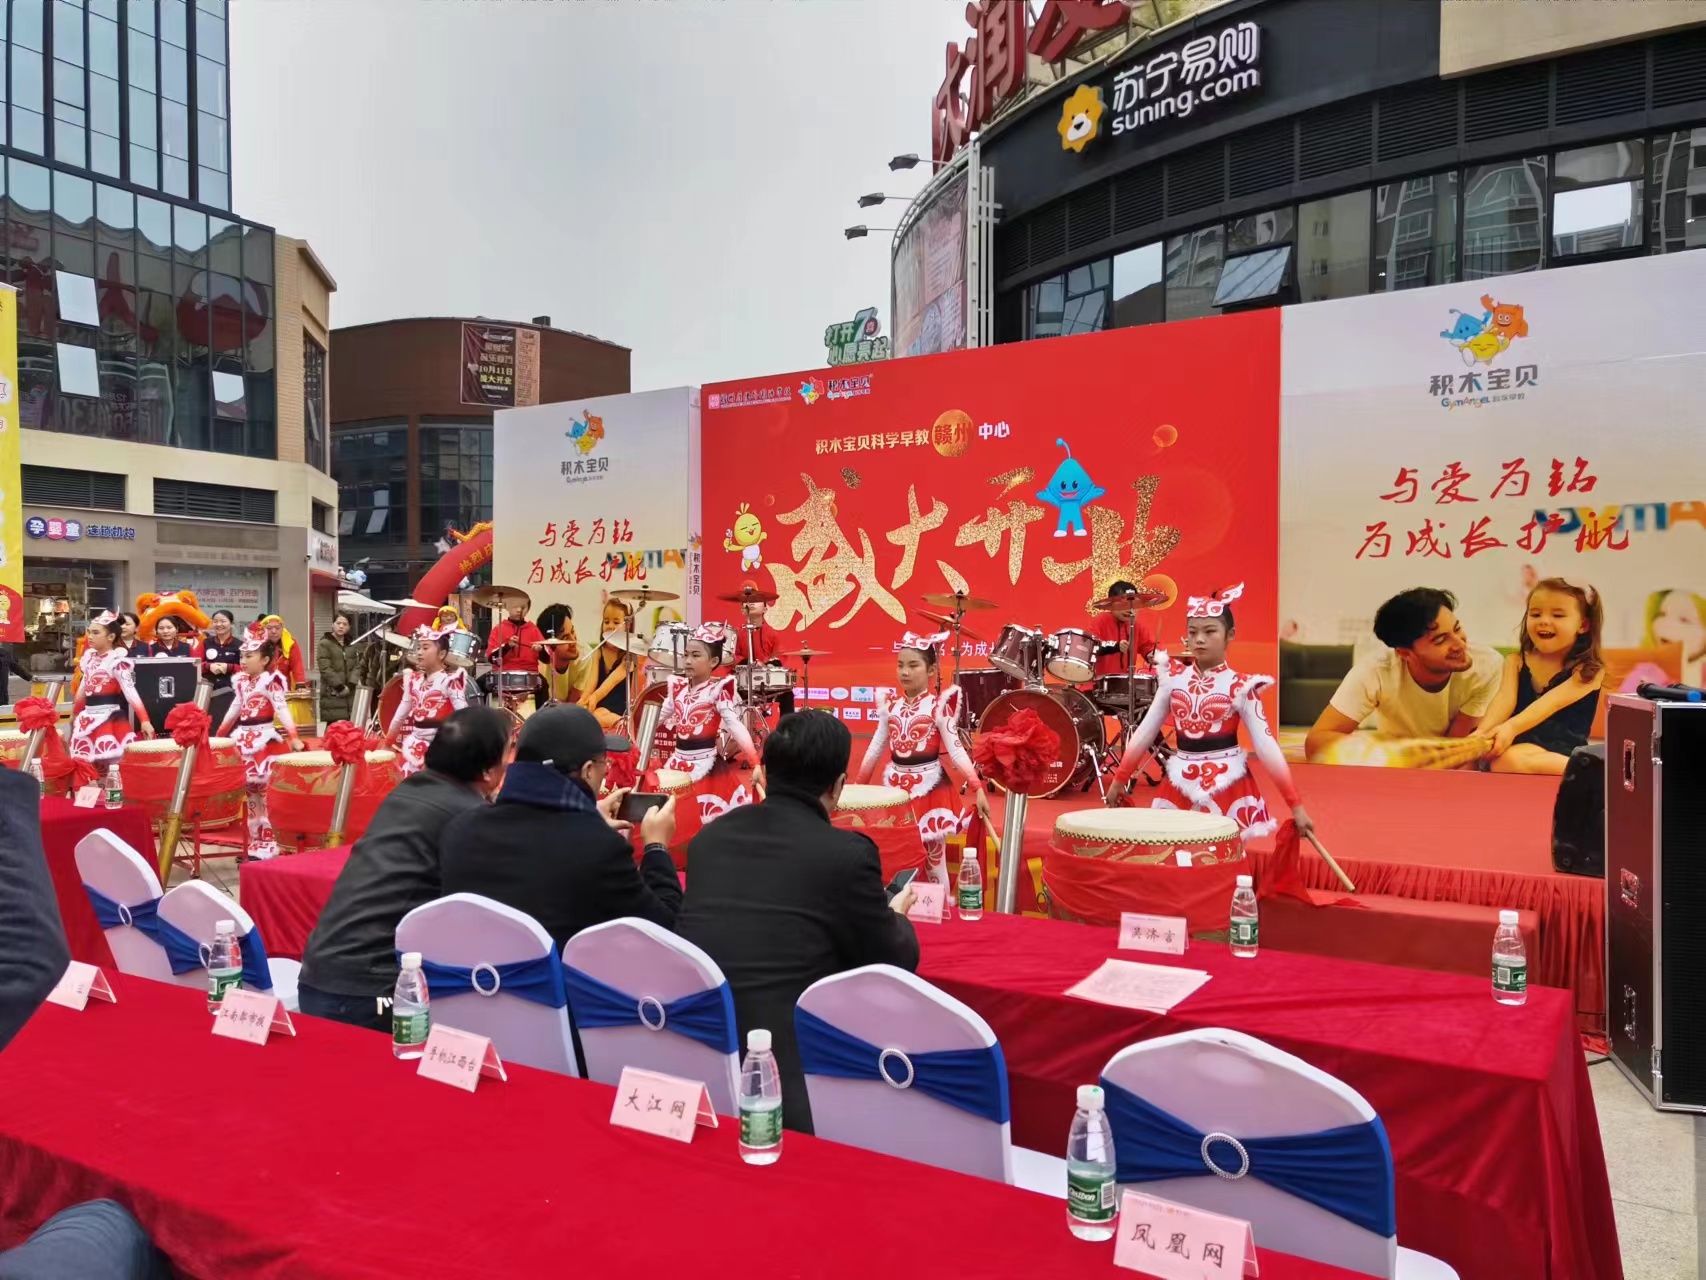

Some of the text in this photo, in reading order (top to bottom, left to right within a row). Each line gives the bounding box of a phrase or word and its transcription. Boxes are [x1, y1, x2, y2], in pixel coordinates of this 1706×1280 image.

[1113, 21, 1260, 112] 苏宁易购
[1112, 68, 1260, 136] suning.com
[1429, 364, 1538, 396] 积木宝贝
[815, 420, 1010, 455] 积木宝贝科学早教 赣州 中心
[560, 457, 609, 475] 积木宝贝
[1379, 456, 1598, 505] 与爱为铭
[29, 519, 80, 537] 孕婴童
[538, 518, 633, 548] 与爱为铭
[1354, 511, 1630, 560] 为成长护航
[527, 555, 648, 585] 为成长护航
[624, 1088, 687, 1119] 大江网
[1130, 1223, 1226, 1269] 凤凰网
